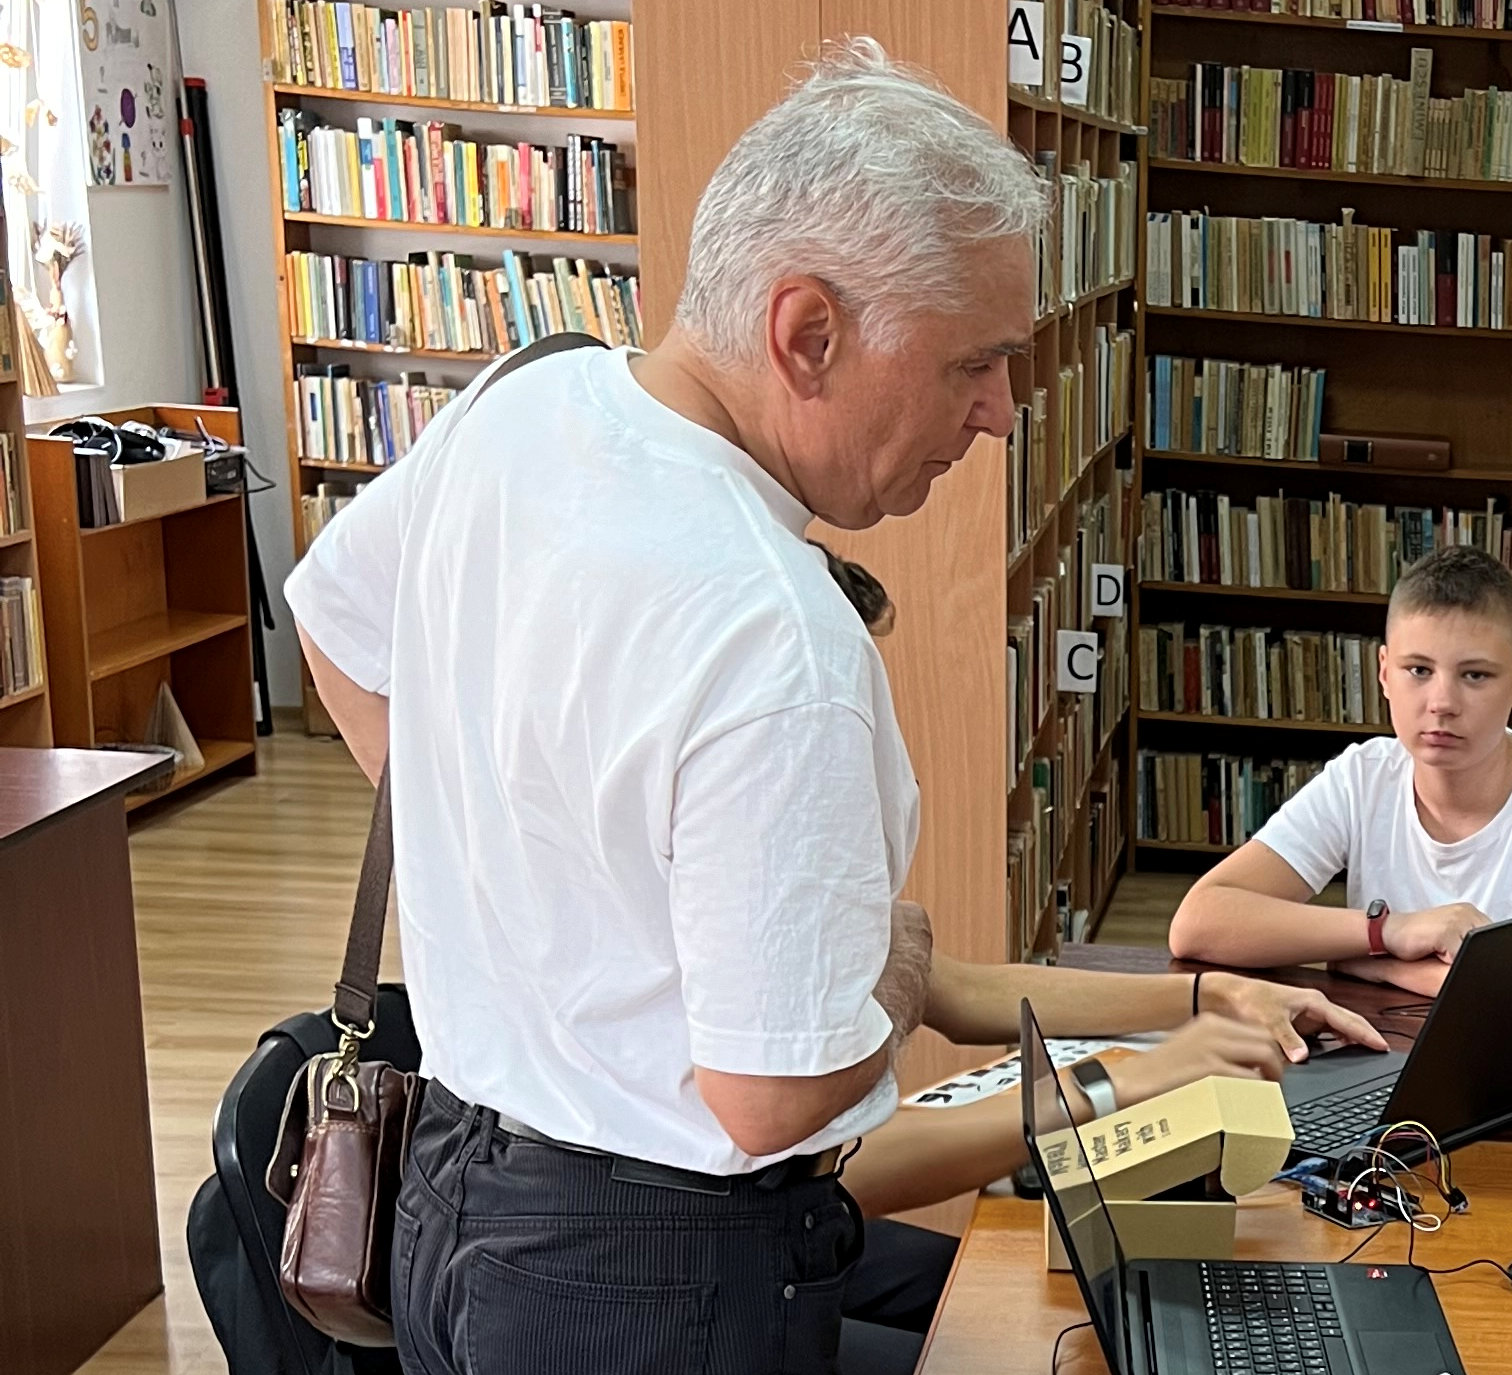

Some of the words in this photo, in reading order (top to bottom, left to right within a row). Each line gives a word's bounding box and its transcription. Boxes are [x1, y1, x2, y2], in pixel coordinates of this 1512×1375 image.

[1008, 8, 1039, 60] A
[1097, 574, 1120, 606] D
[1067, 643, 1094, 680] C
